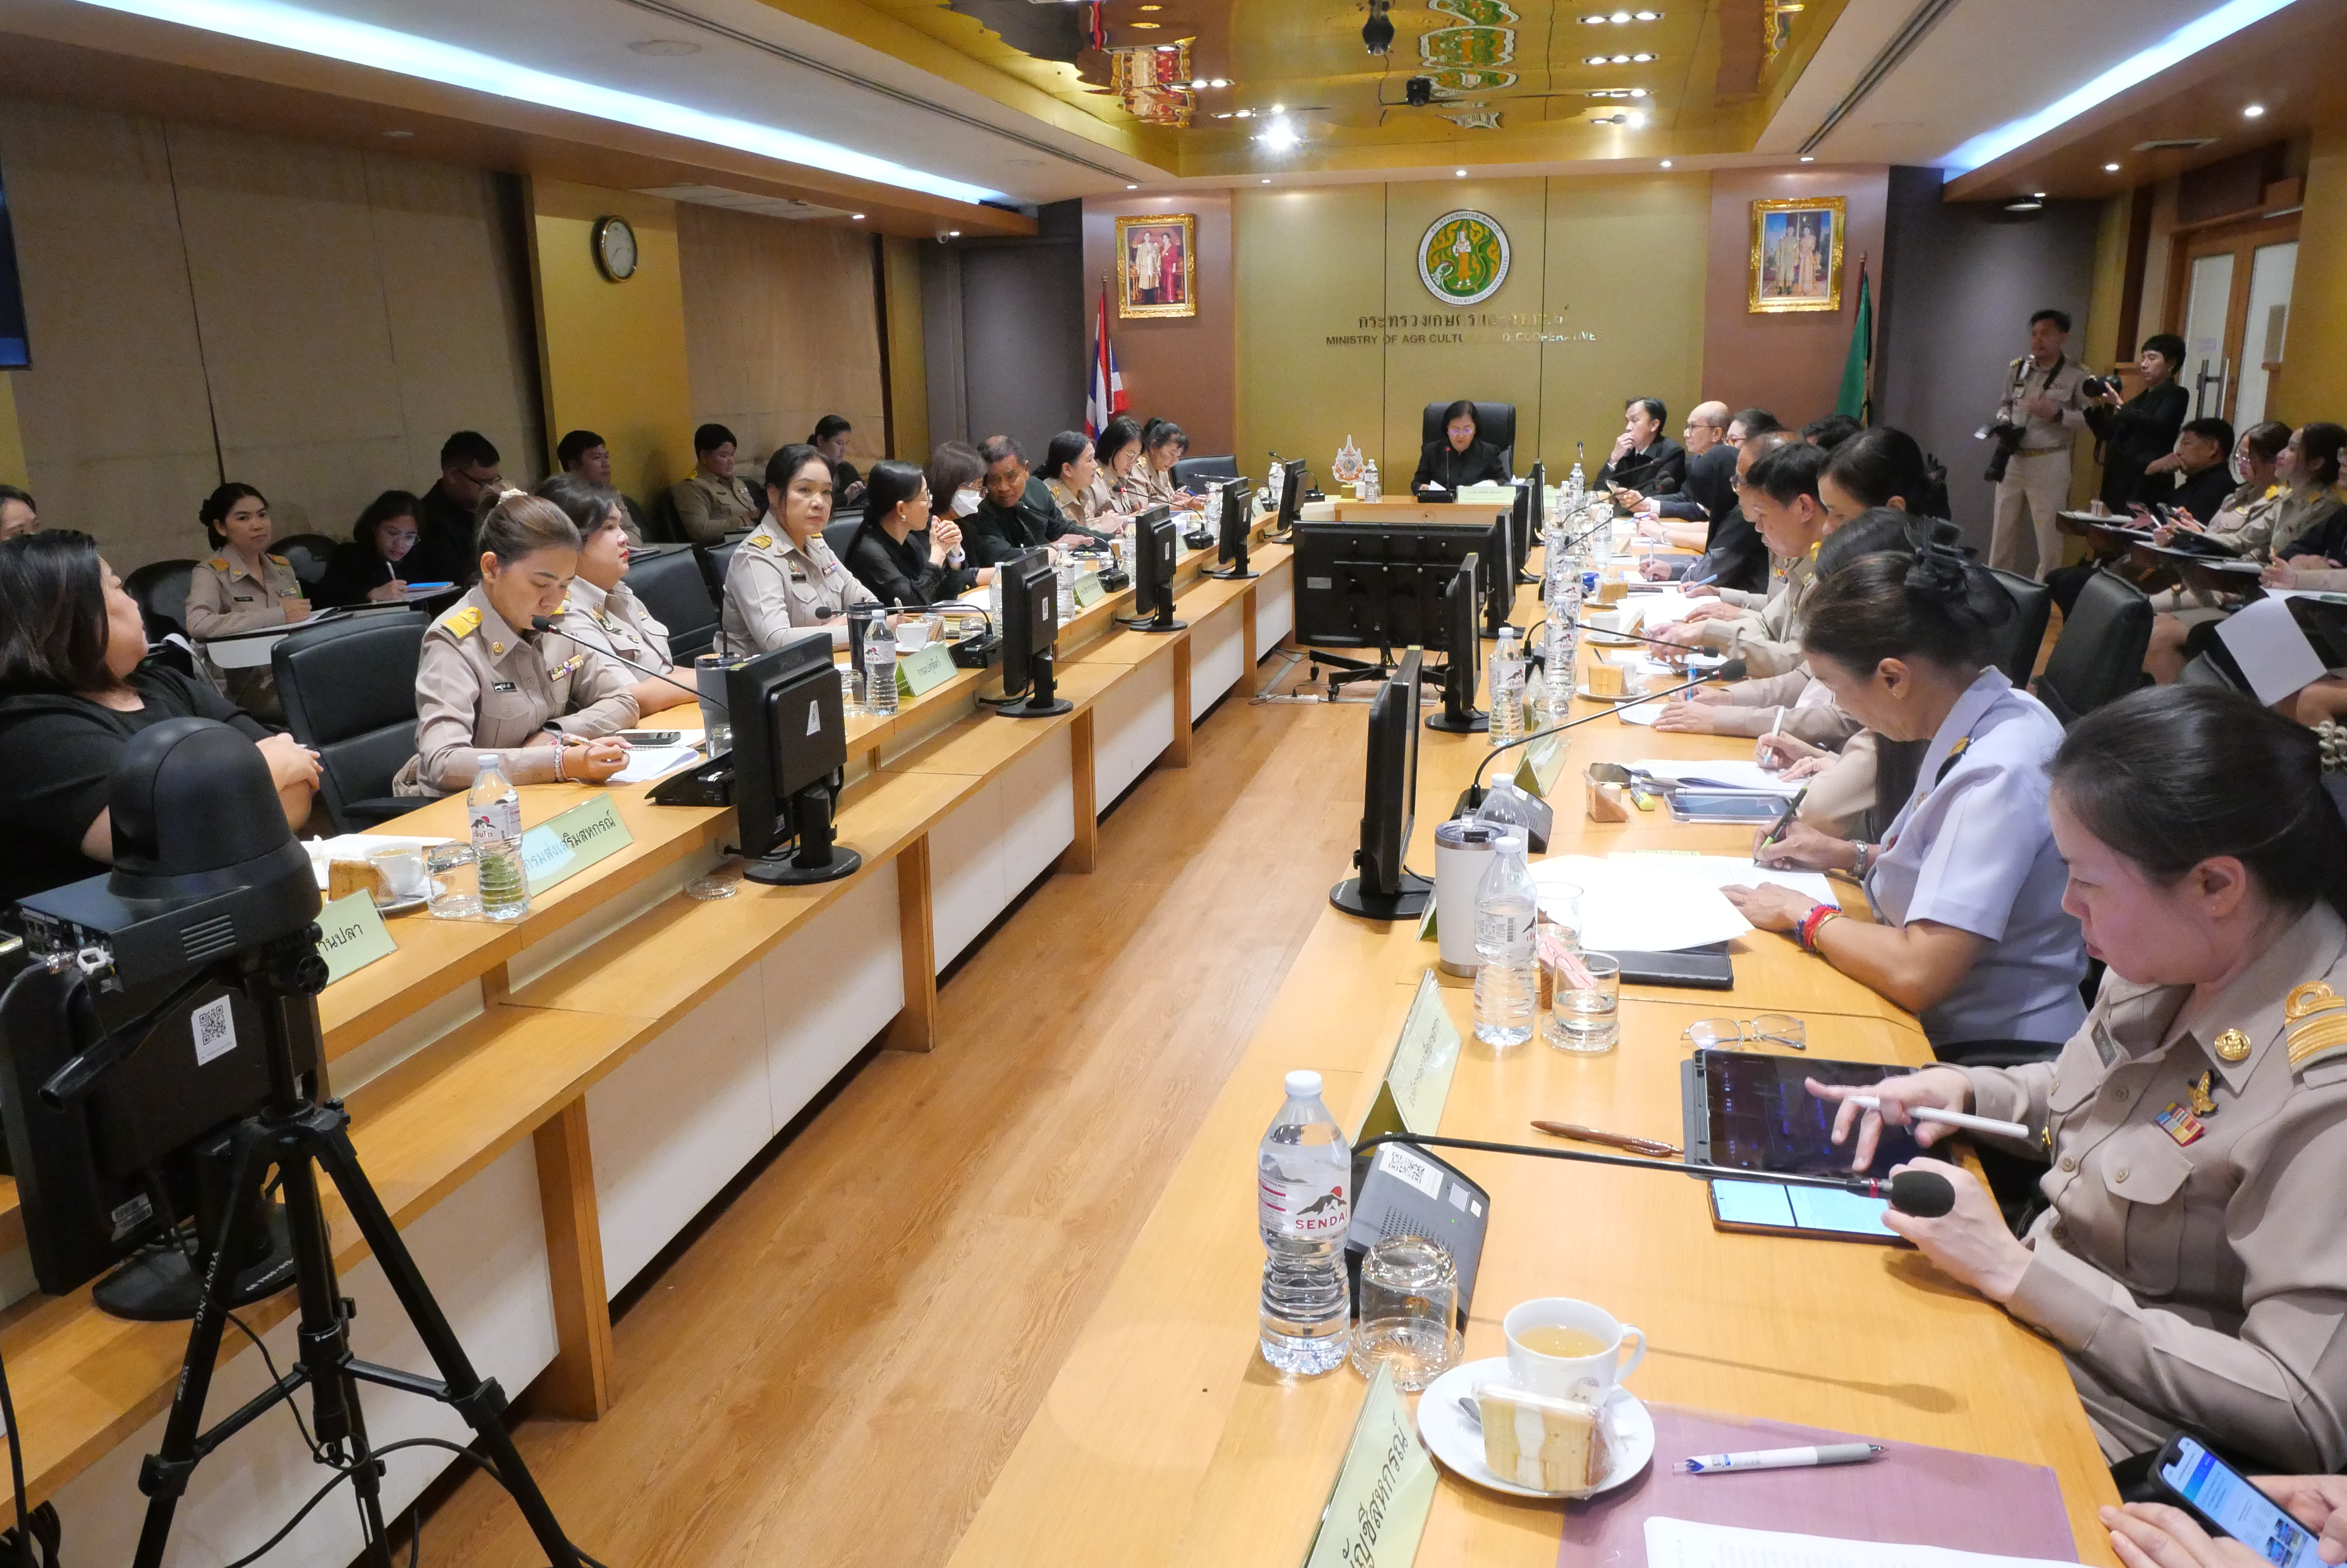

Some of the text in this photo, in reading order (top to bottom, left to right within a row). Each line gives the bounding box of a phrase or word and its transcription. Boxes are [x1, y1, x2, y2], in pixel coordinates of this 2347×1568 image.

[1326, 335, 1377, 345] MINISTRY
[1383, 334, 1397, 344] OF
[1402, 333, 1464, 344] AGRCULT
[524, 809, 616, 872] กรมส่งเสริมสหกรณ์
[1296, 1208, 1347, 1230] SENDAI
